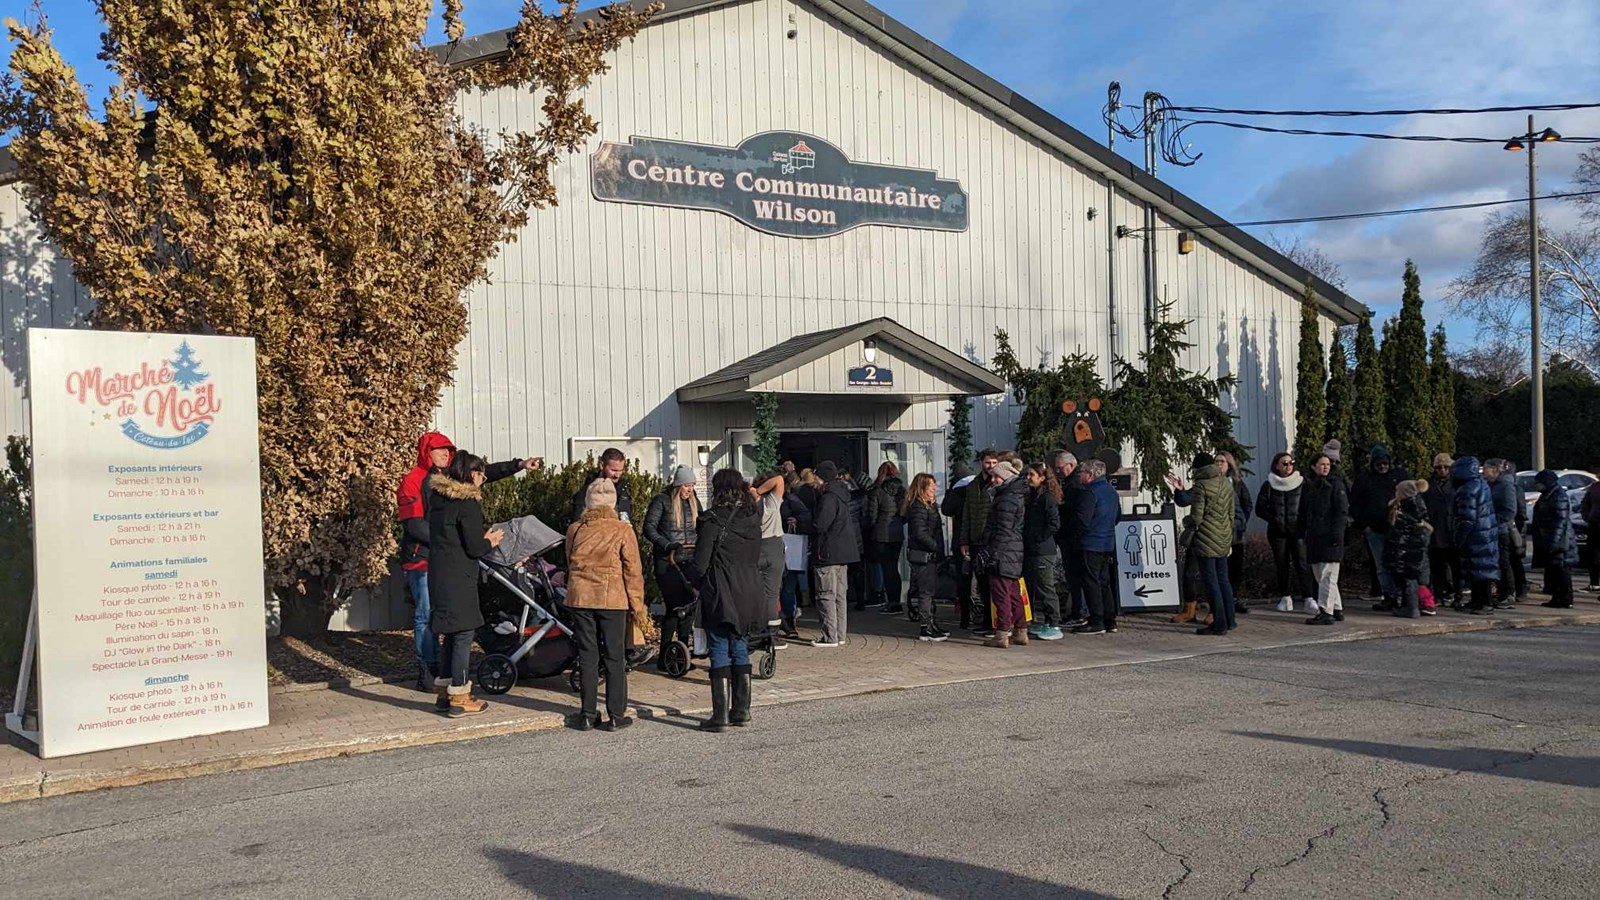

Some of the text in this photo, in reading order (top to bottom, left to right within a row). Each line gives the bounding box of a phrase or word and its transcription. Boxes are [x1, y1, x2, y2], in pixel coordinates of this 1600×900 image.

[627, 159, 942, 209] Centre Communautaire
[752, 200, 837, 225] Wilson
[865, 366, 876, 380] 2
[65, 359, 175, 406] Marché
[117, 383, 221, 432] de Noël
[108, 465, 157, 474] Exposants
[115, 477, 149, 485] Samedi
[108, 489, 152, 498] Dimanche
[93, 512, 142, 522] Exposants
[145, 511, 191, 519] extérieurs
[117, 524, 151, 533] Samedi
[110, 537, 155, 546] Dimanche
[110, 556, 207, 569] Animations familiales
[144, 570, 178, 580] samedi
[1124, 571, 1171, 579] Toilettes
[104, 584, 139, 594] Kiosque
[141, 583, 167, 592] photo
[101, 599, 120, 607] Tour
[138, 594, 170, 604] carriole
[75, 610, 124, 622] Maquillage
[126, 609, 142, 618] fluo
[115, 622, 136, 631] Père
[138, 620, 158, 629] Noël
[106, 634, 156, 644] Illumination
[171, 630, 194, 639] sapin
[157, 643, 170, 652] the
[92, 660, 136, 672] Spectacle
[151, 652, 208, 665] Grand-Messe
[144, 673, 190, 686] dimanche
[109, 691, 144, 702] Kiosque
[147, 688, 172, 698] photo
[107, 706, 127, 715] Tour
[144, 700, 176, 710] carriole
[77, 719, 123, 731] Animation
[139, 713, 160, 722] foule
